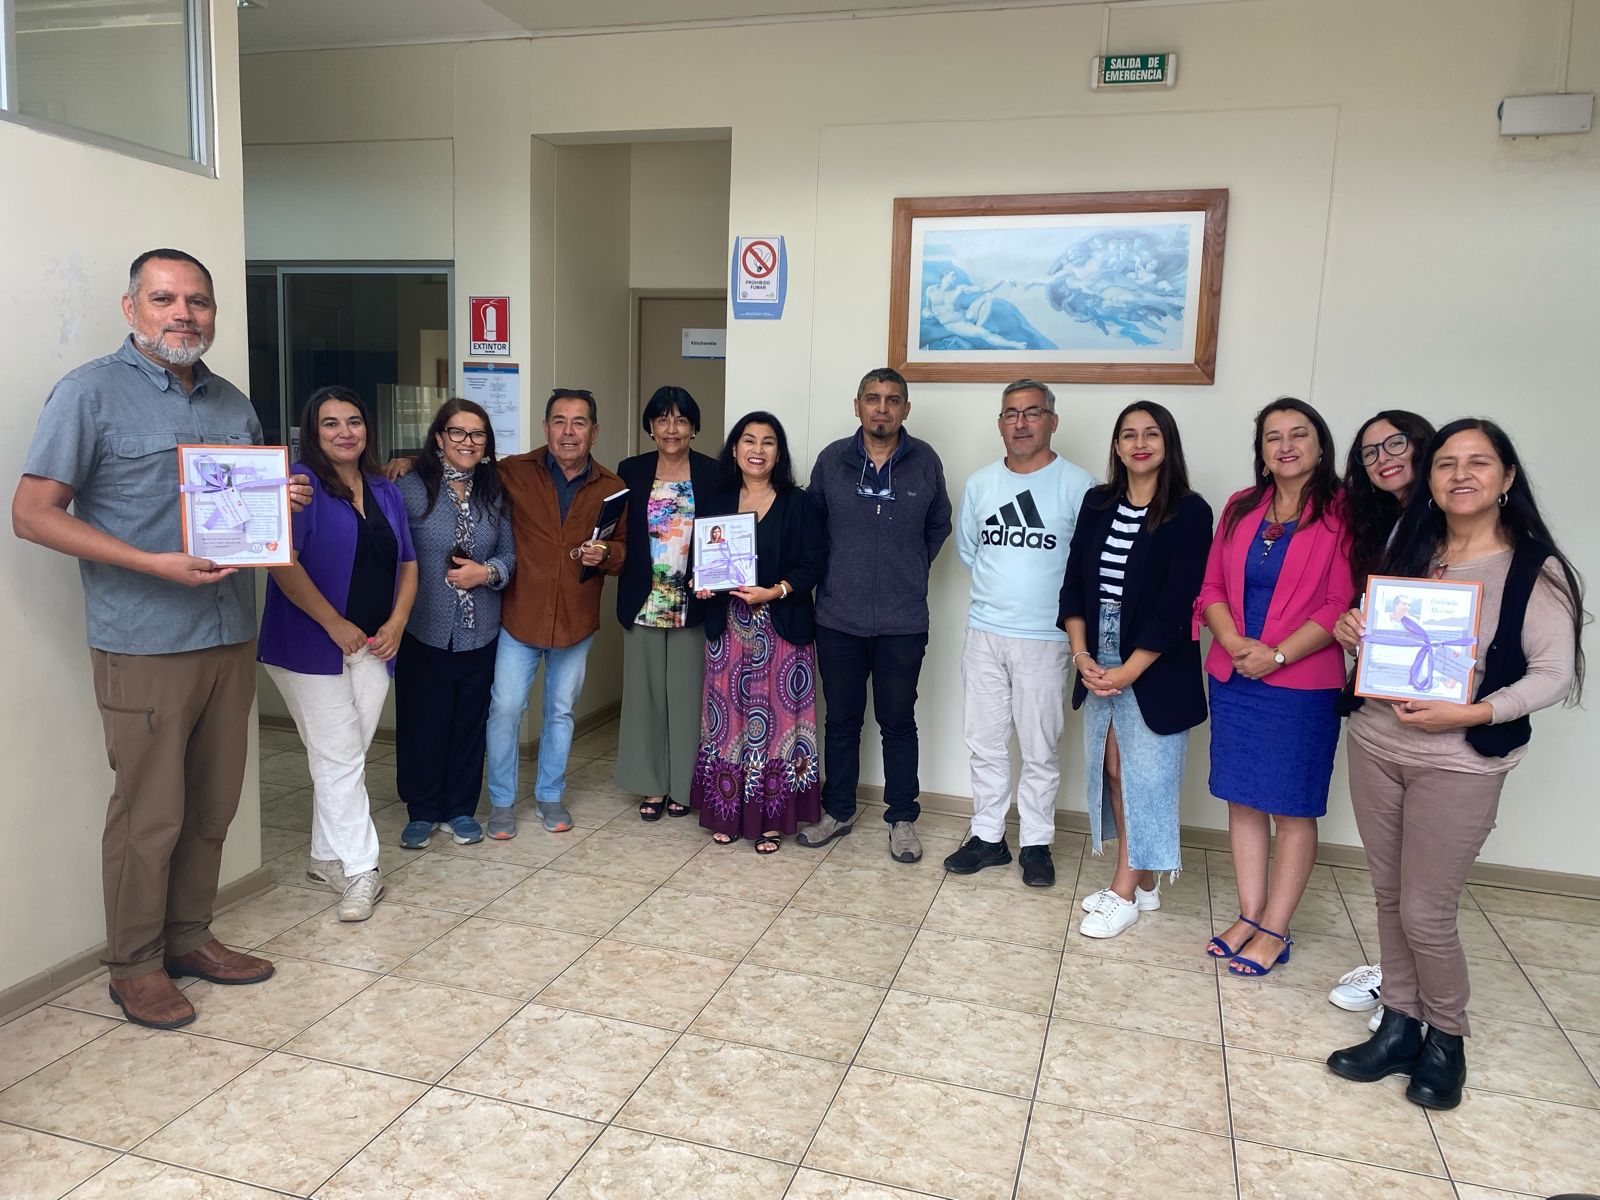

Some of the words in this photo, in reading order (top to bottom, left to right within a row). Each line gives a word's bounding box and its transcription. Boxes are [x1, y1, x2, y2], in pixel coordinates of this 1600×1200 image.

[1110, 57, 1142, 69] SALIDA
[1148, 56, 1160, 68] DE
[1105, 69, 1162, 82] EMERGENCIA
[473, 343, 507, 351] EXTINTOR
[981, 525, 1057, 550] adidas
